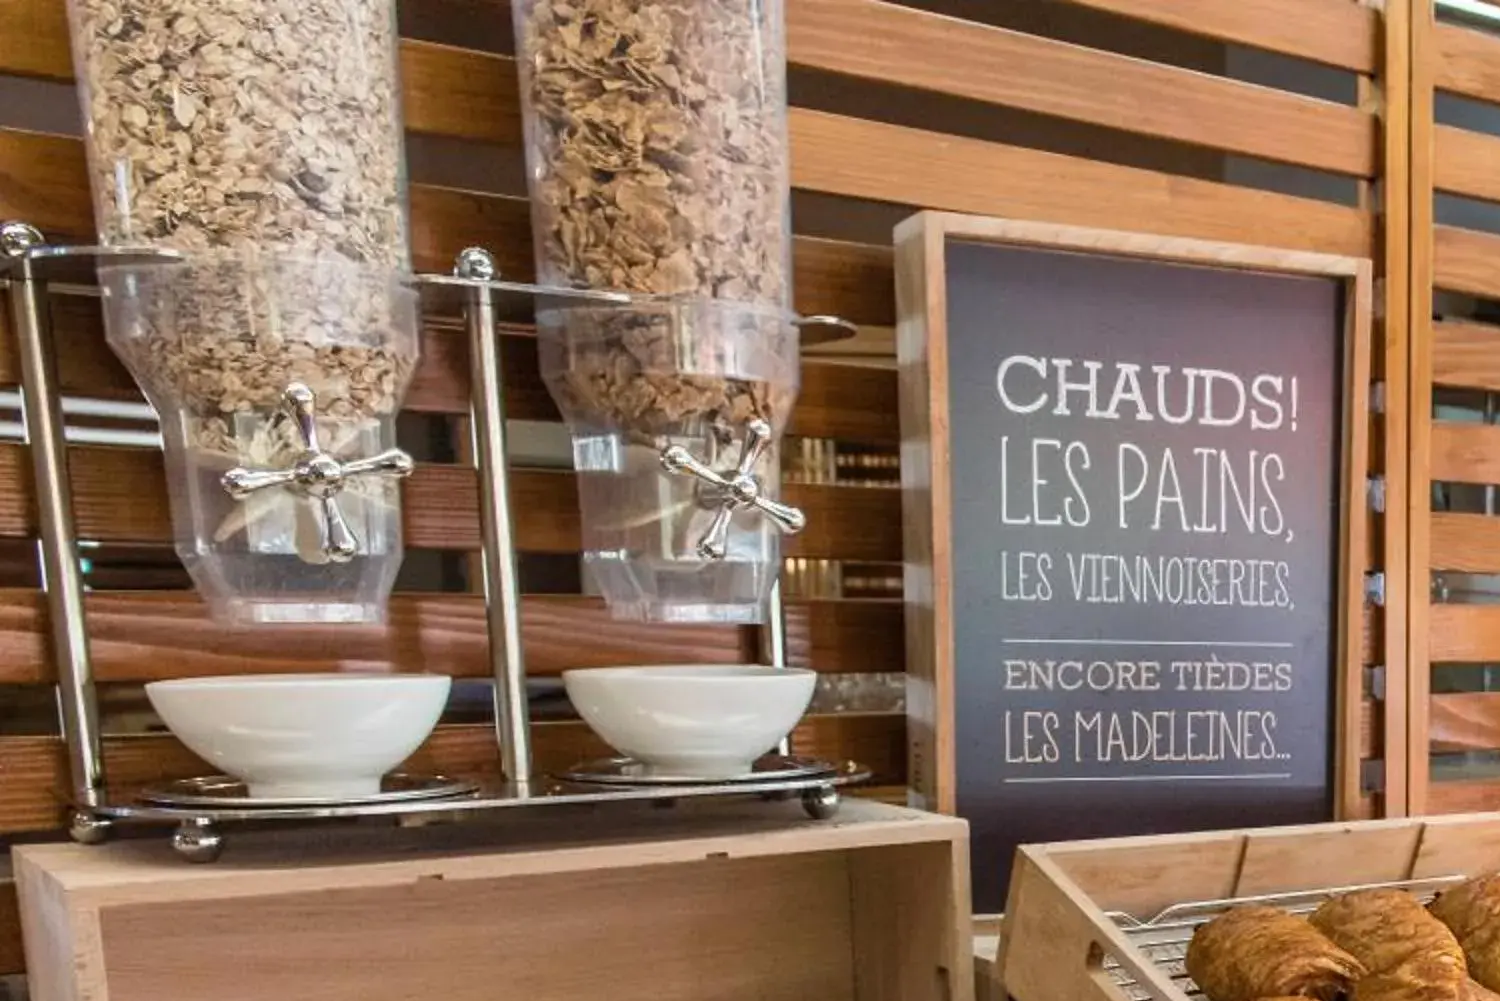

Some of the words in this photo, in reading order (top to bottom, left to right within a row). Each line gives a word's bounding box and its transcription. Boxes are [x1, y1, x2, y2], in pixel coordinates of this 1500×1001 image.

[997, 355, 1298, 431] CHAUDS!
[1001, 436, 1091, 527] LES
[1119, 443, 1295, 543] PAINS,
[1001, 551, 1053, 602] LES
[1066, 552, 1295, 610] VIENNOISERIES,
[1003, 660, 1161, 691] ENCORE
[1171, 653, 1293, 691] TIÈDES
[1005, 710, 1060, 763] LES
